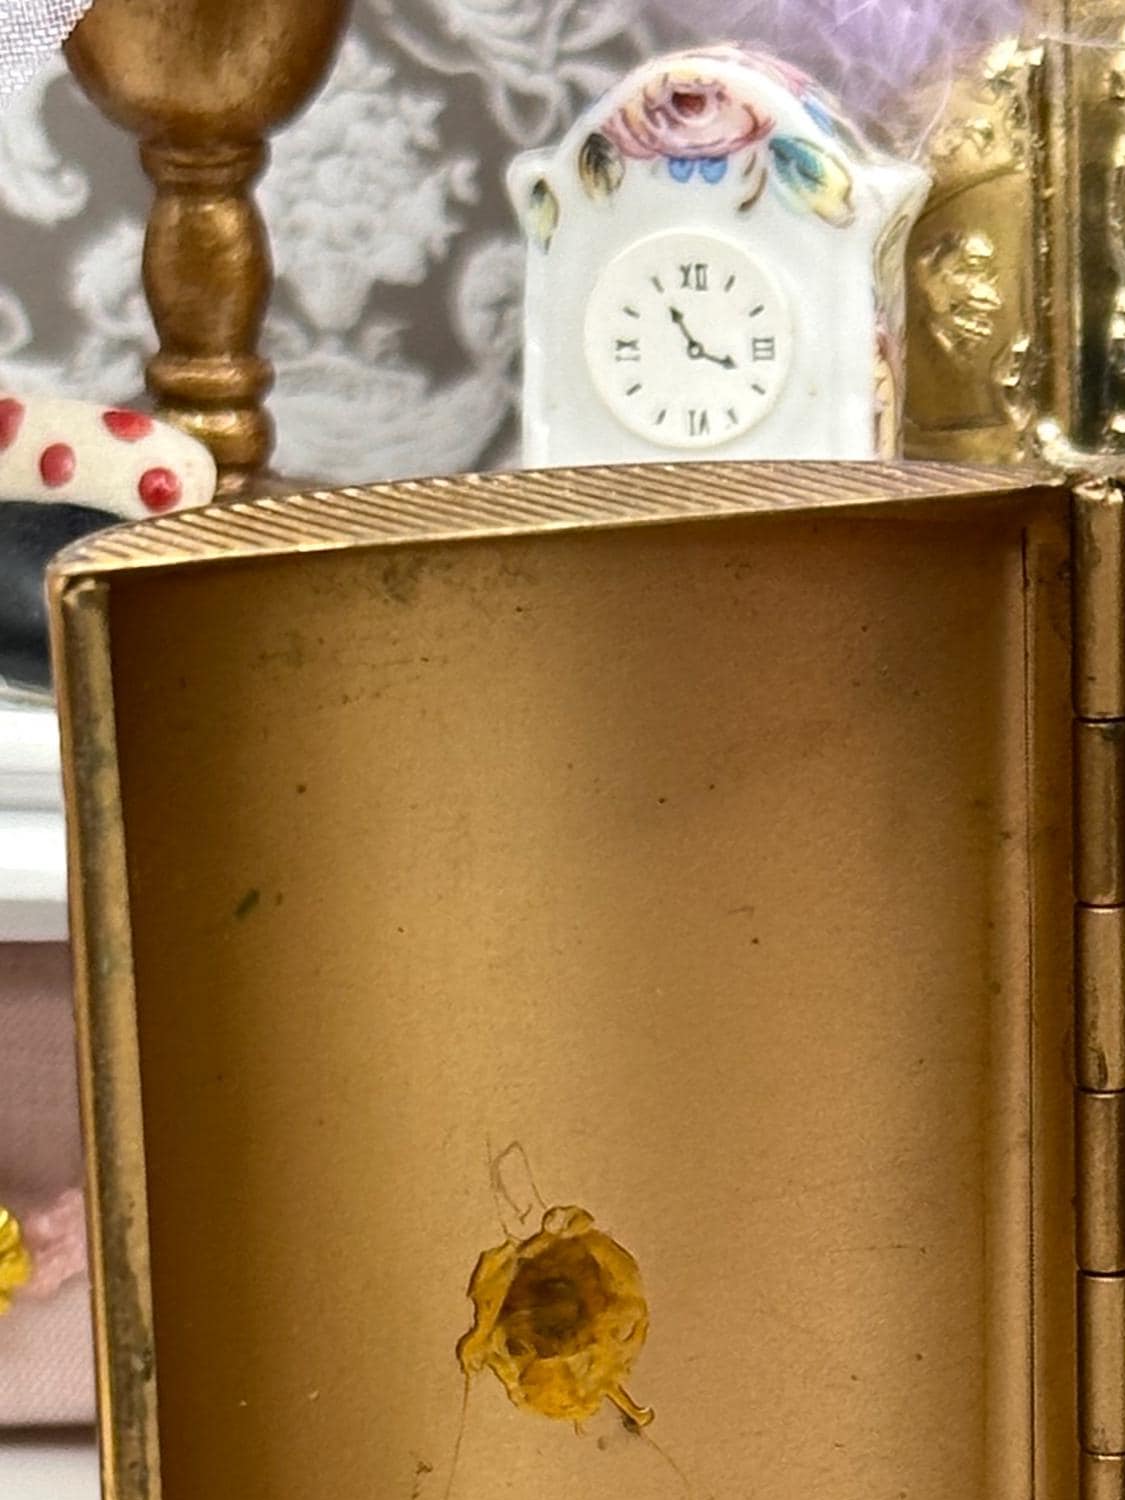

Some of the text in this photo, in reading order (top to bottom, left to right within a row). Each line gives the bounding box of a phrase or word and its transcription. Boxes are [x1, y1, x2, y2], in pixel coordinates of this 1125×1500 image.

[679, 263, 708, 291] XII
[615, 338, 641, 362] IX
[752, 337, 776, 361] III
[688, 409, 710, 437] VI
